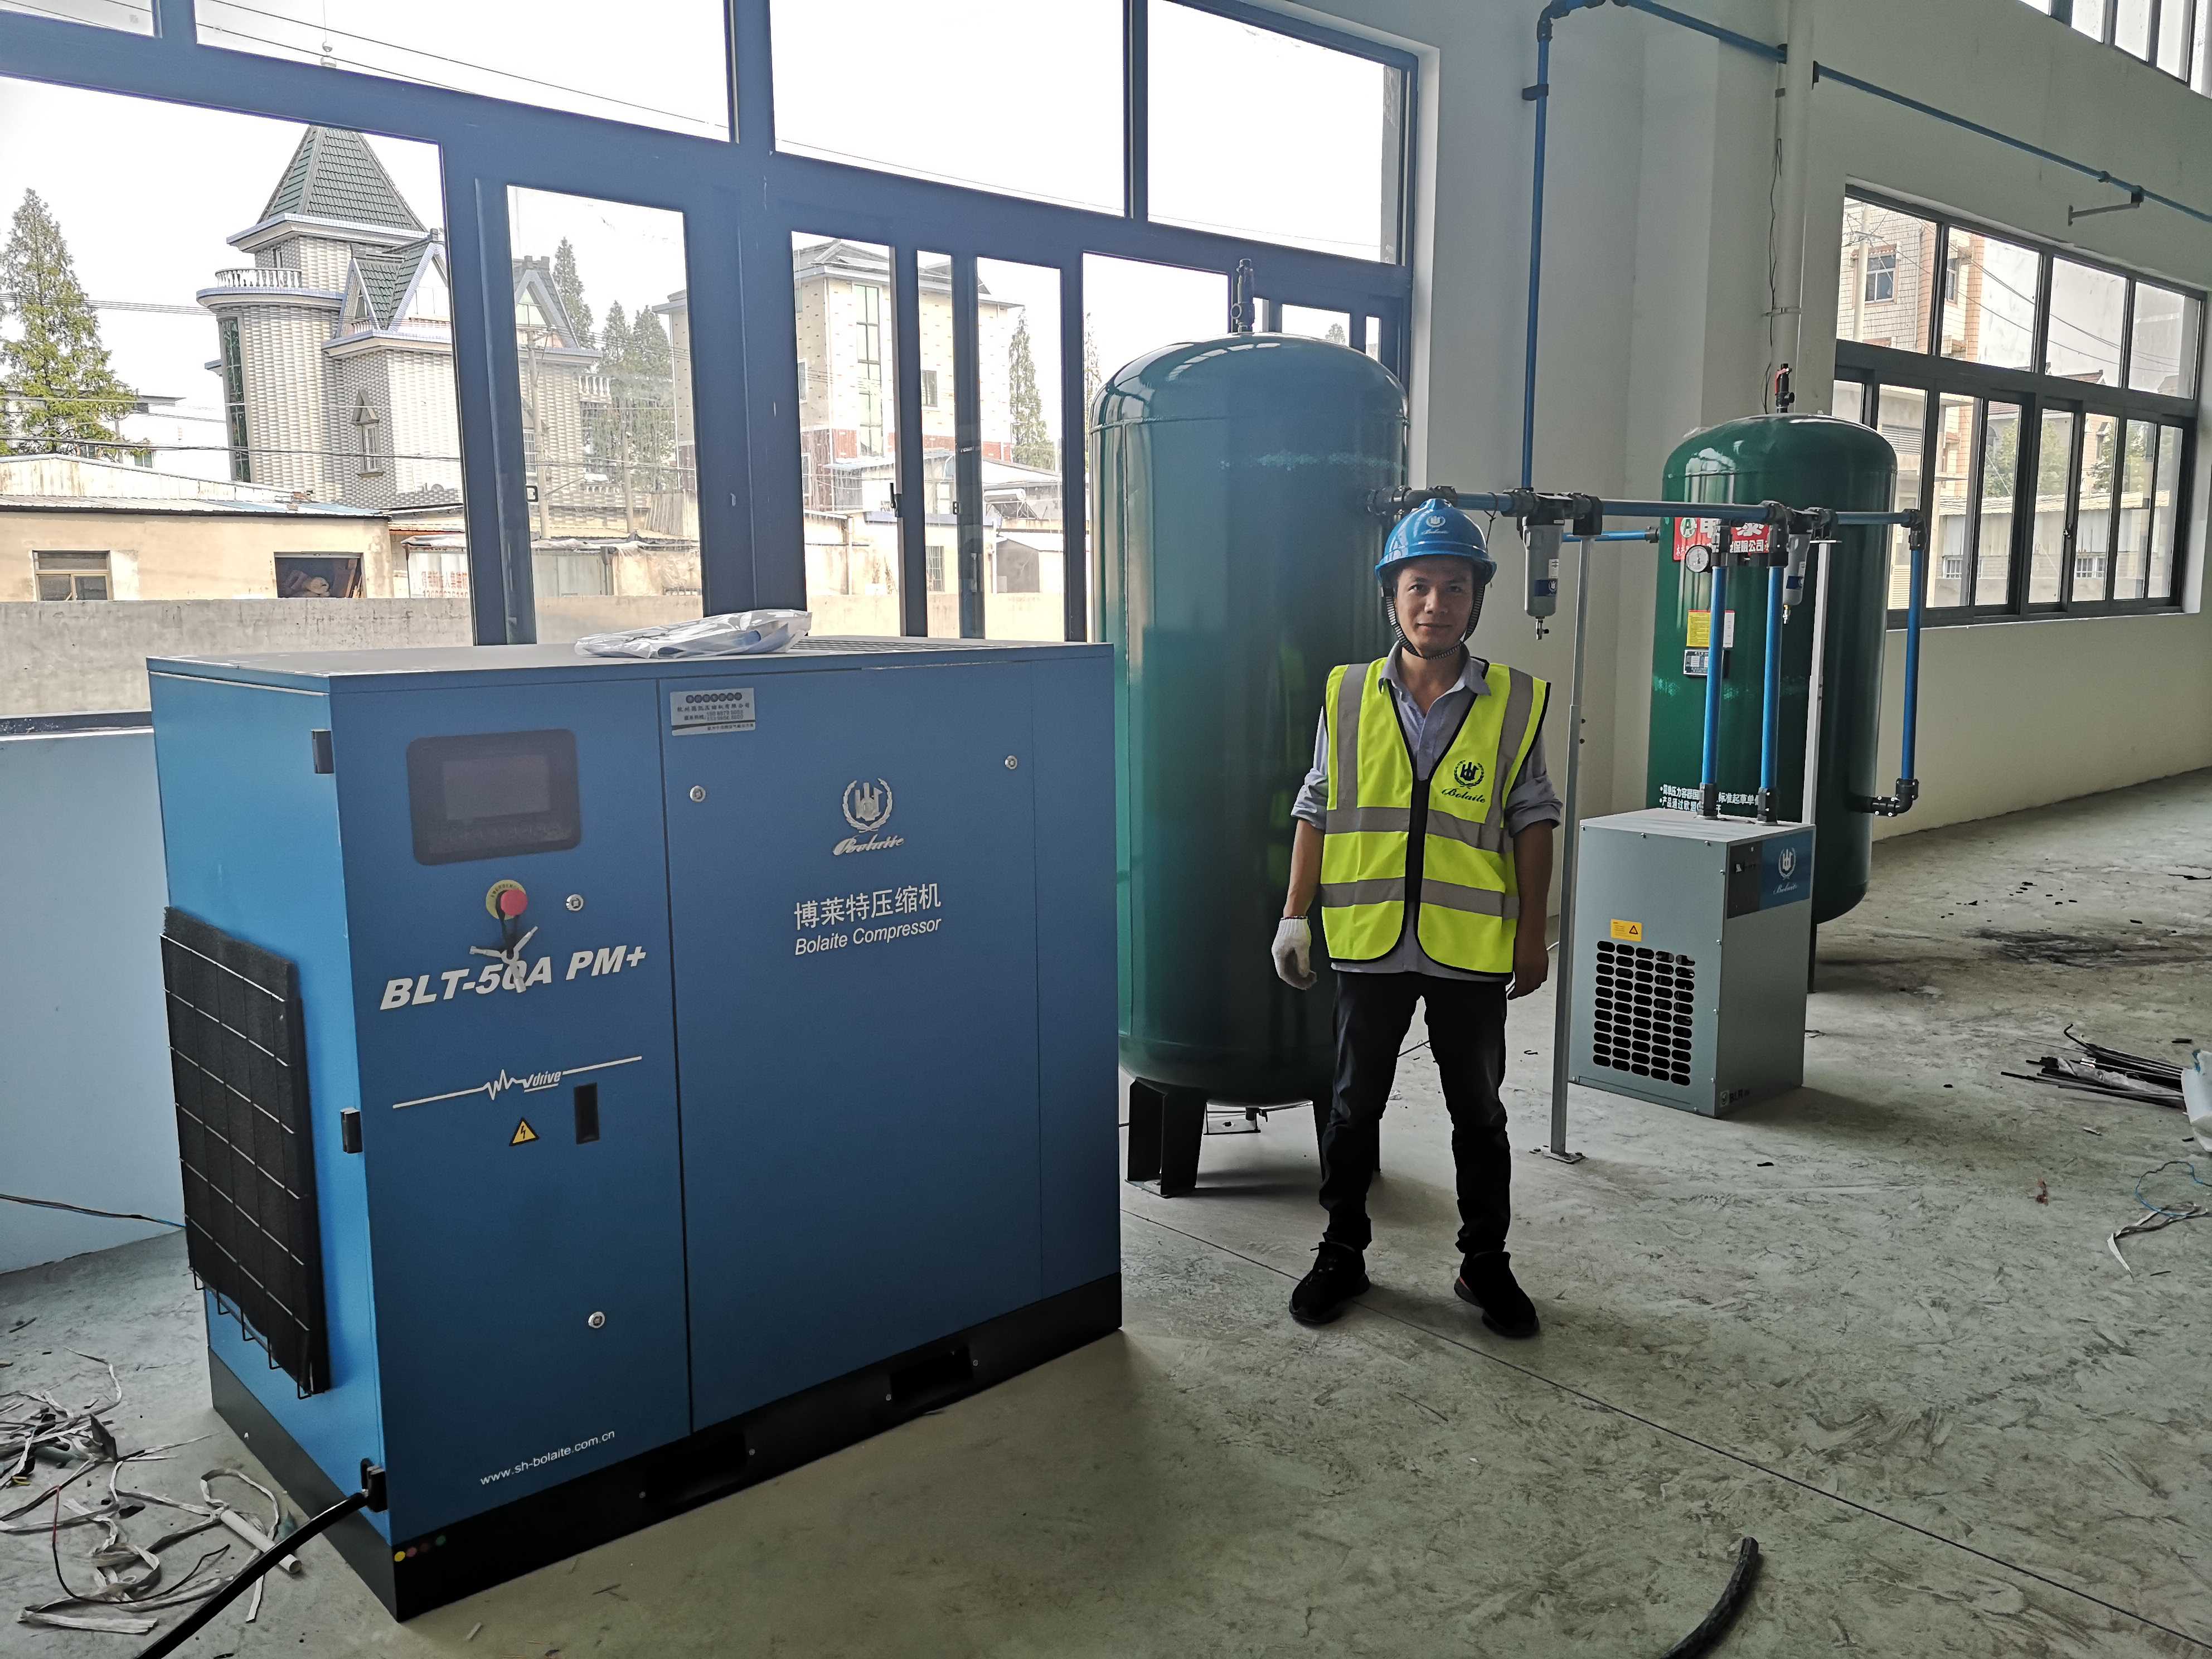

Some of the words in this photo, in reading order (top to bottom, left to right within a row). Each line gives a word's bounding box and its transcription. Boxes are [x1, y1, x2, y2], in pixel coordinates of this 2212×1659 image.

[1441, 788, 1486, 803] Bolaite
[794, 883, 942, 931] 博莱特压缩机
[795, 933, 848, 955] Bolaite
[853, 918, 942, 944] Compressor
[565, 945, 647, 981] PM+
[481, 1430, 616, 1485] www.sh-bolaite.com.cn
